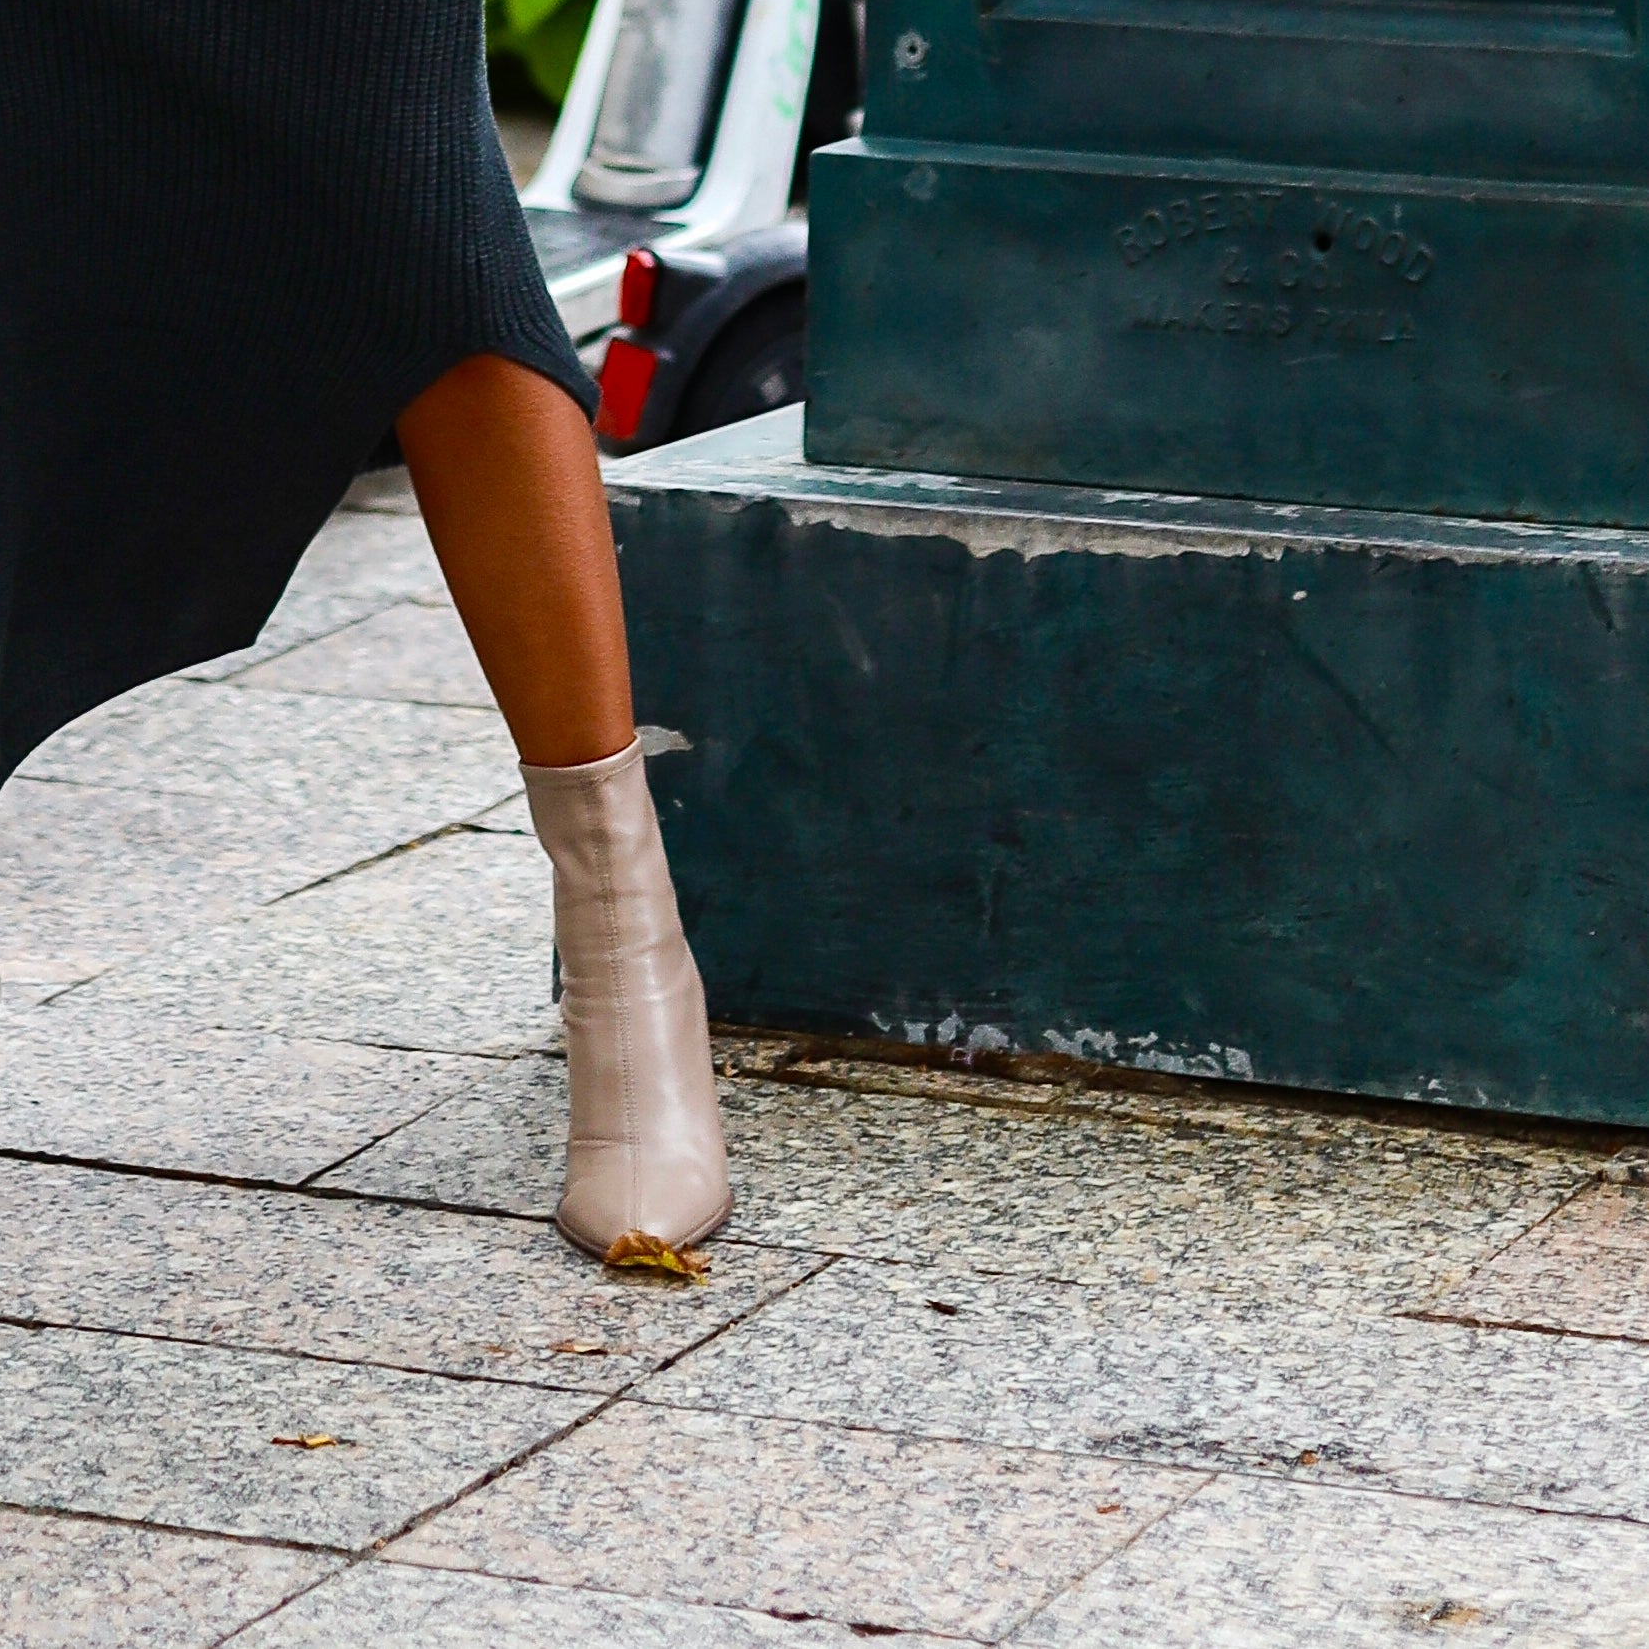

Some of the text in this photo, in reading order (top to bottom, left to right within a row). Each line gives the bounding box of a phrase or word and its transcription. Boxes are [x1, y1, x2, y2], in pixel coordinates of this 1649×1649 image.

[1113, 189, 1435, 284] ROBERT WOOD
[1221, 246, 1251, 286] &
